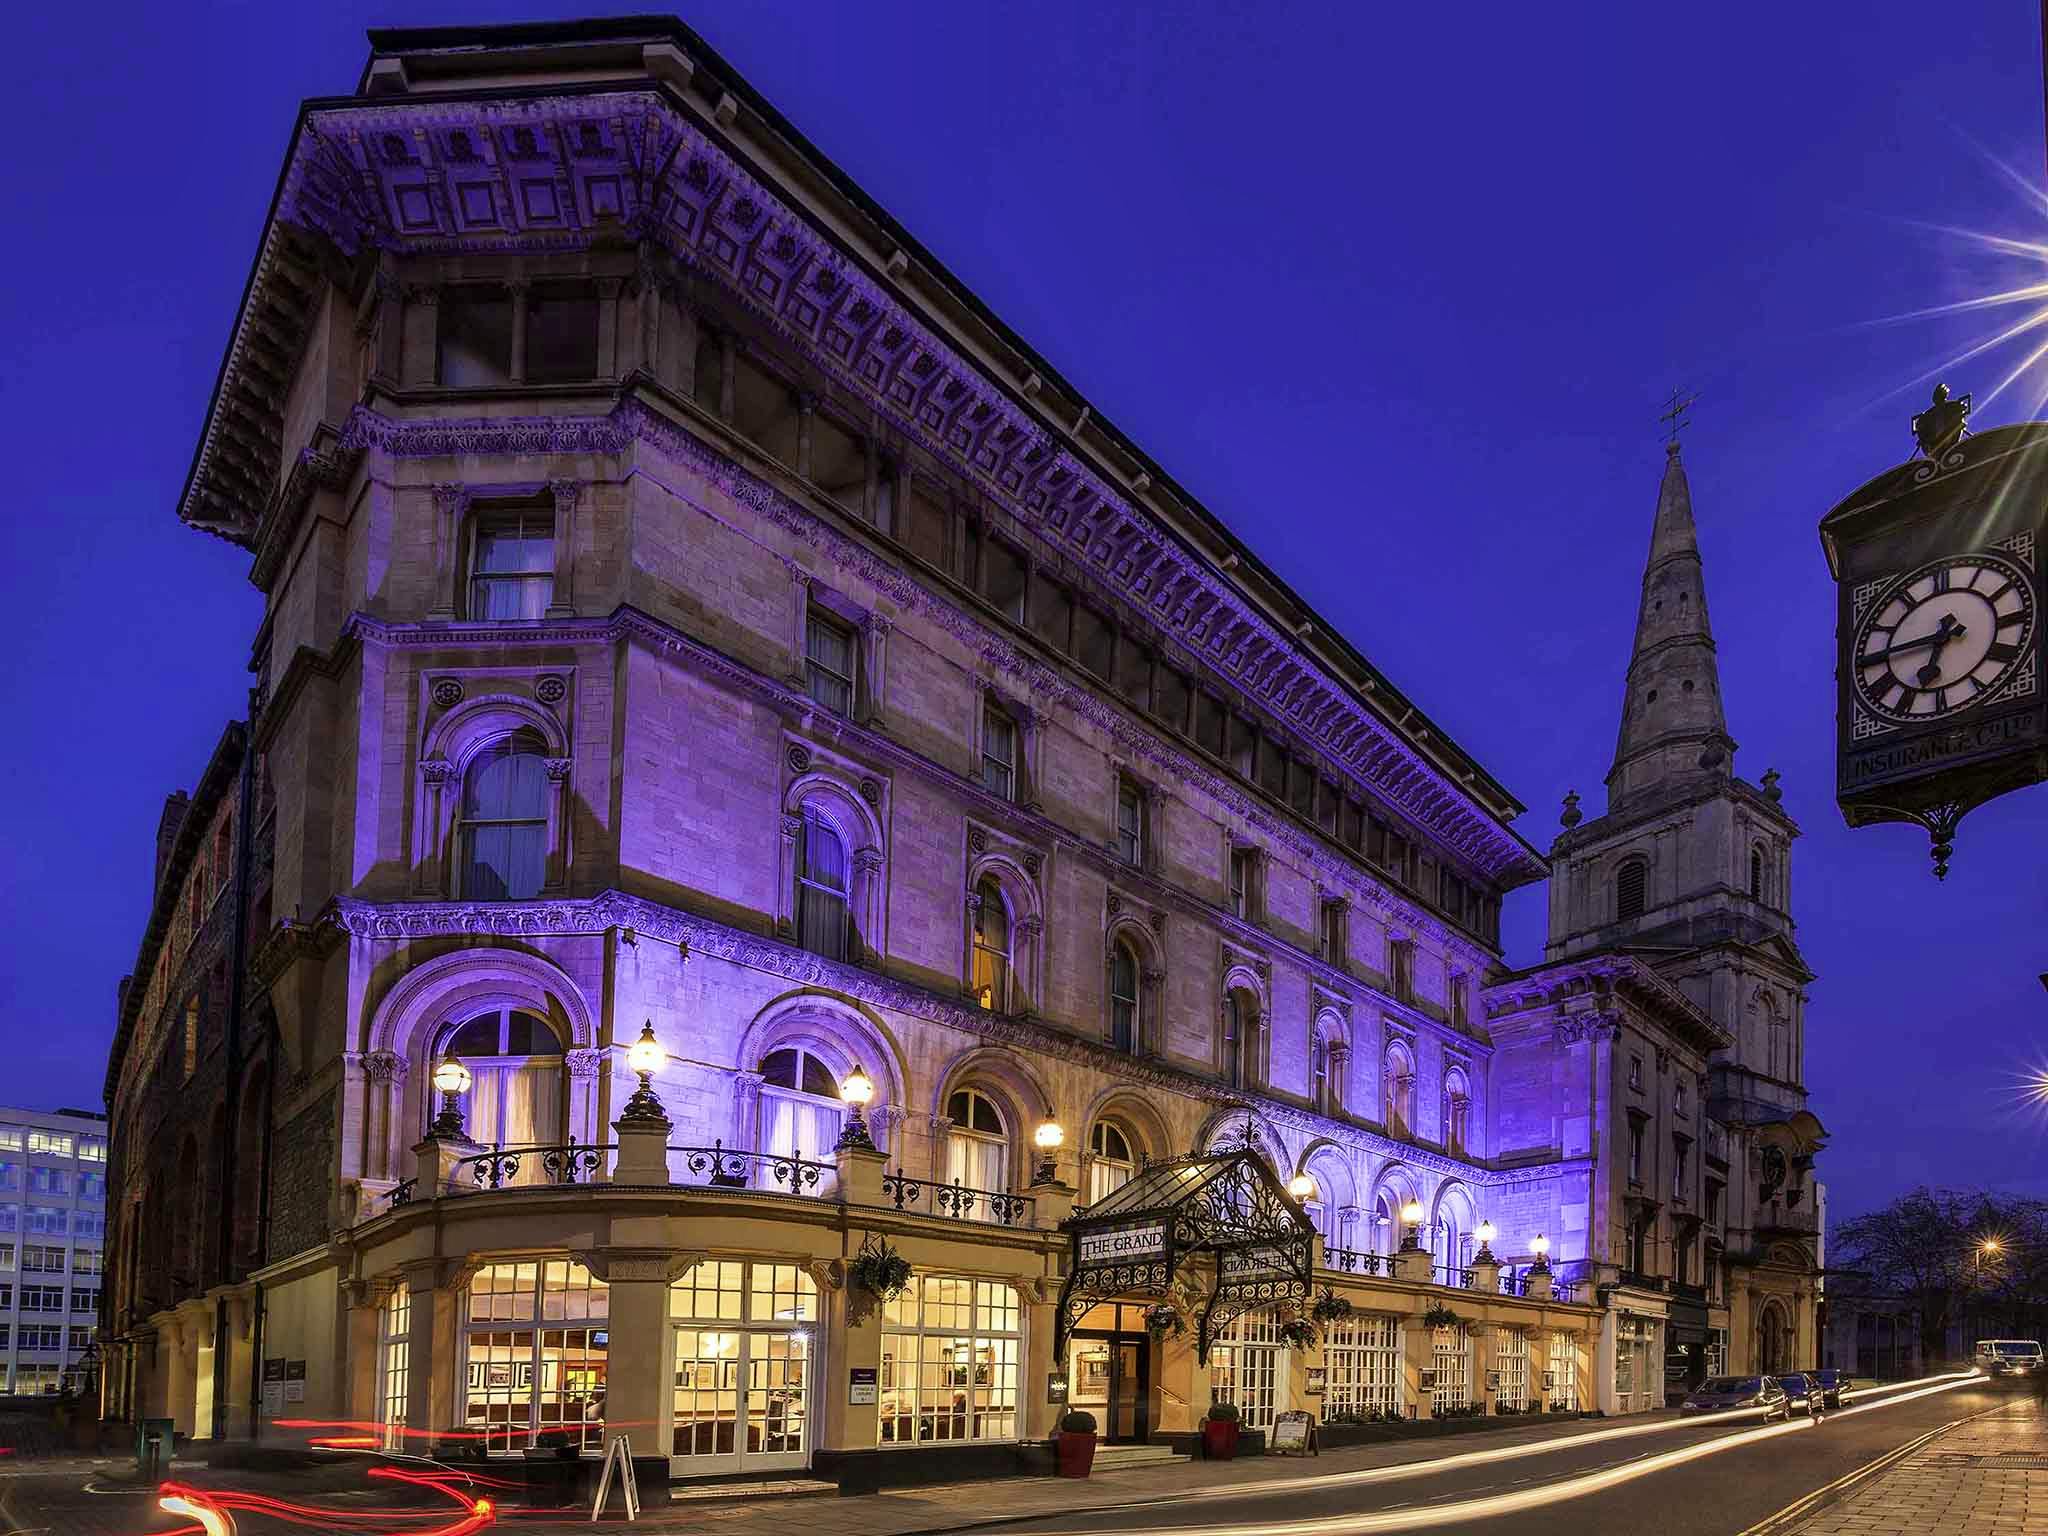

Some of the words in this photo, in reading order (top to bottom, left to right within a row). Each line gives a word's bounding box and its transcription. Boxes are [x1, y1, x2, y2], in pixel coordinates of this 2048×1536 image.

[1856, 735, 1968, 774] INSURANCE
[1082, 1239, 1109, 1256] THE
[1114, 1233, 1163, 1250] GRAND
